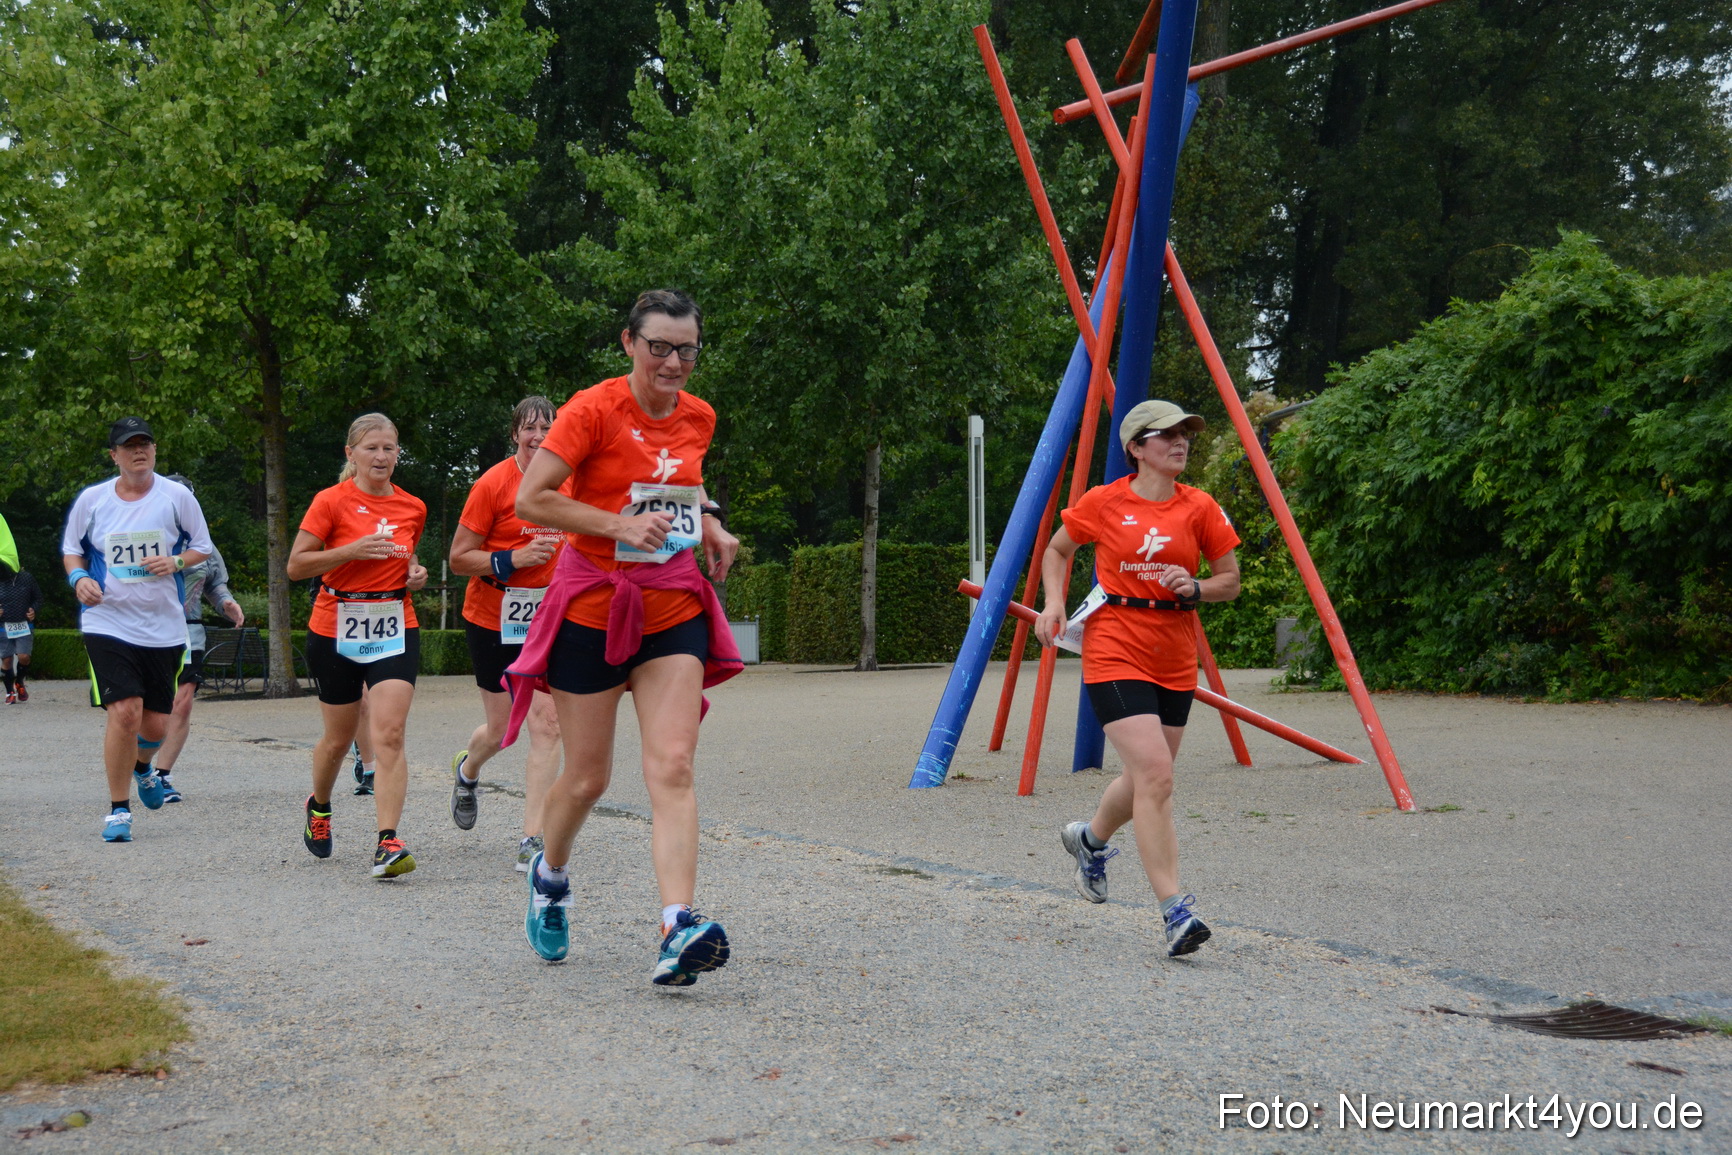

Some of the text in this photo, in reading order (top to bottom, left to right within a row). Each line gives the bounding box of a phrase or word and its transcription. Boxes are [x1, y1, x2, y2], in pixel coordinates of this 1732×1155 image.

[112, 542, 160, 564] 2111
[128, 568, 150, 577] Tanja
[1119, 561, 1169, 573] funrunne
[369, 603, 398, 614] BOCK
[8, 623, 27, 631] 2385
[345, 616, 399, 639] 2143
[359, 645, 385, 655] Conny
